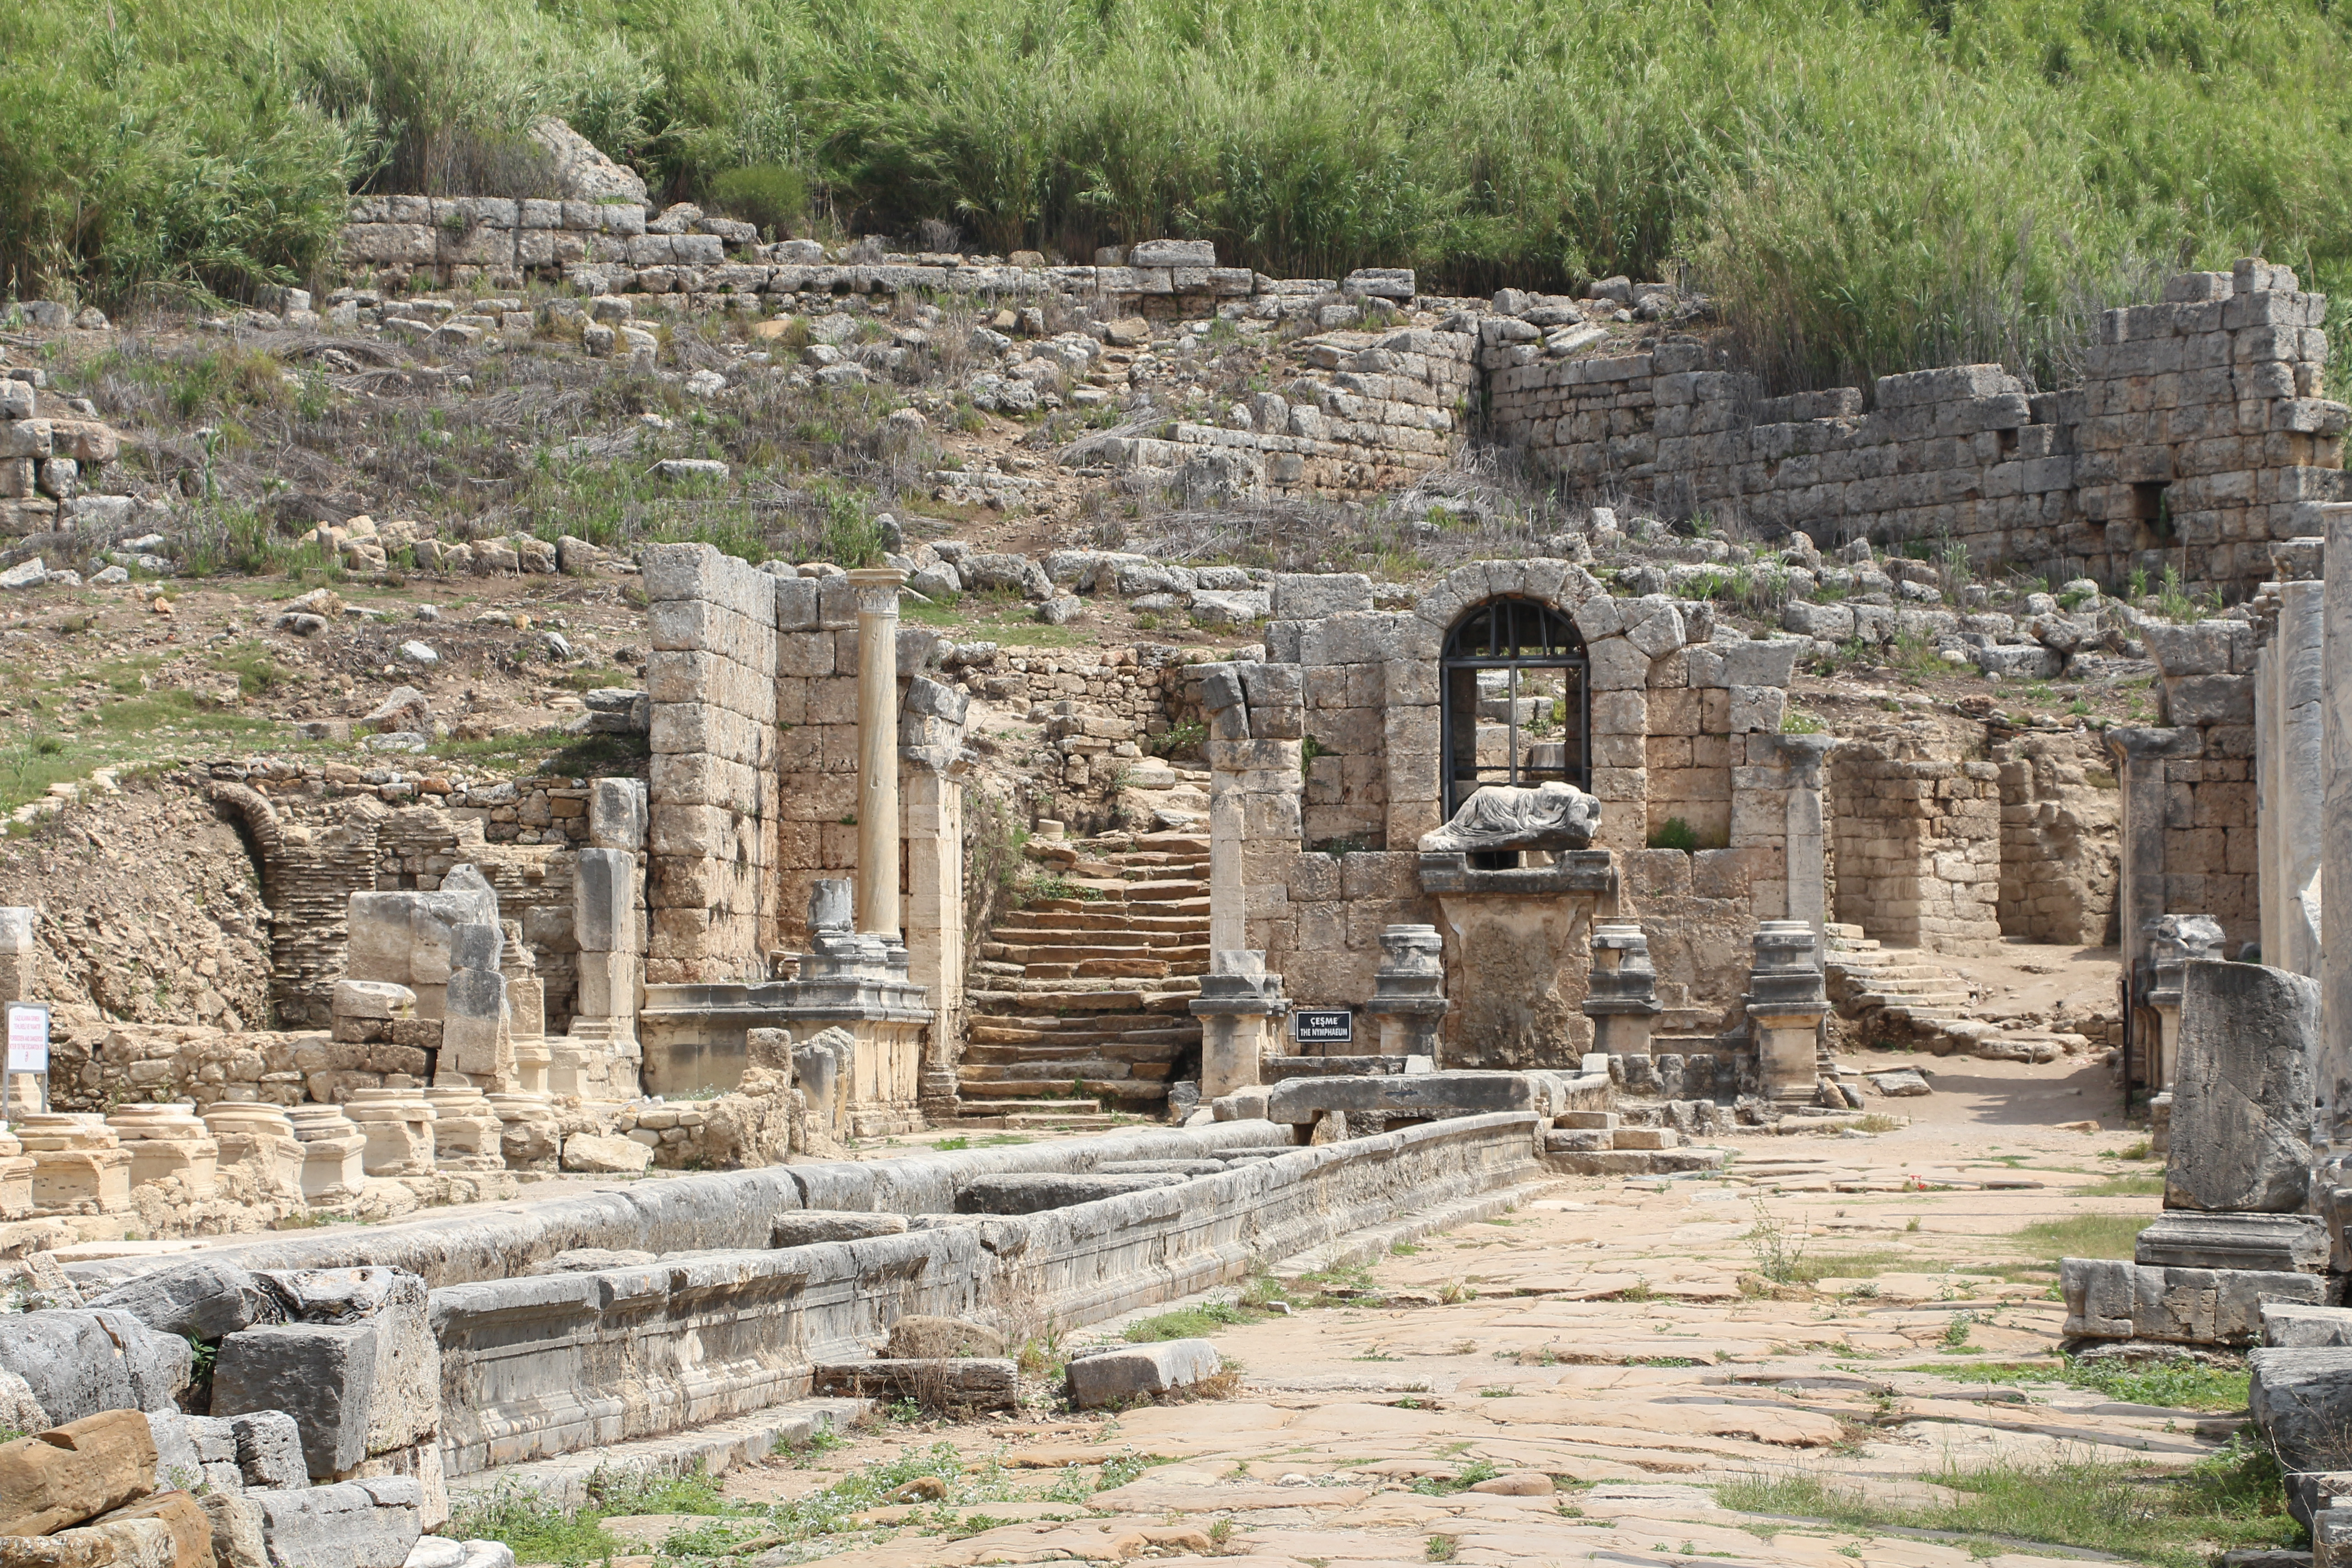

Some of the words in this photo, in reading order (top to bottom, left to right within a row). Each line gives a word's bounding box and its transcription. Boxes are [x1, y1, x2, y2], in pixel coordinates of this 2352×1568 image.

[1310, 1017, 1338, 1027] ÇEŞME
[1300, 1028, 1311, 1037] THE
[1312, 1028, 1347, 1036] NYMPHAEUM
